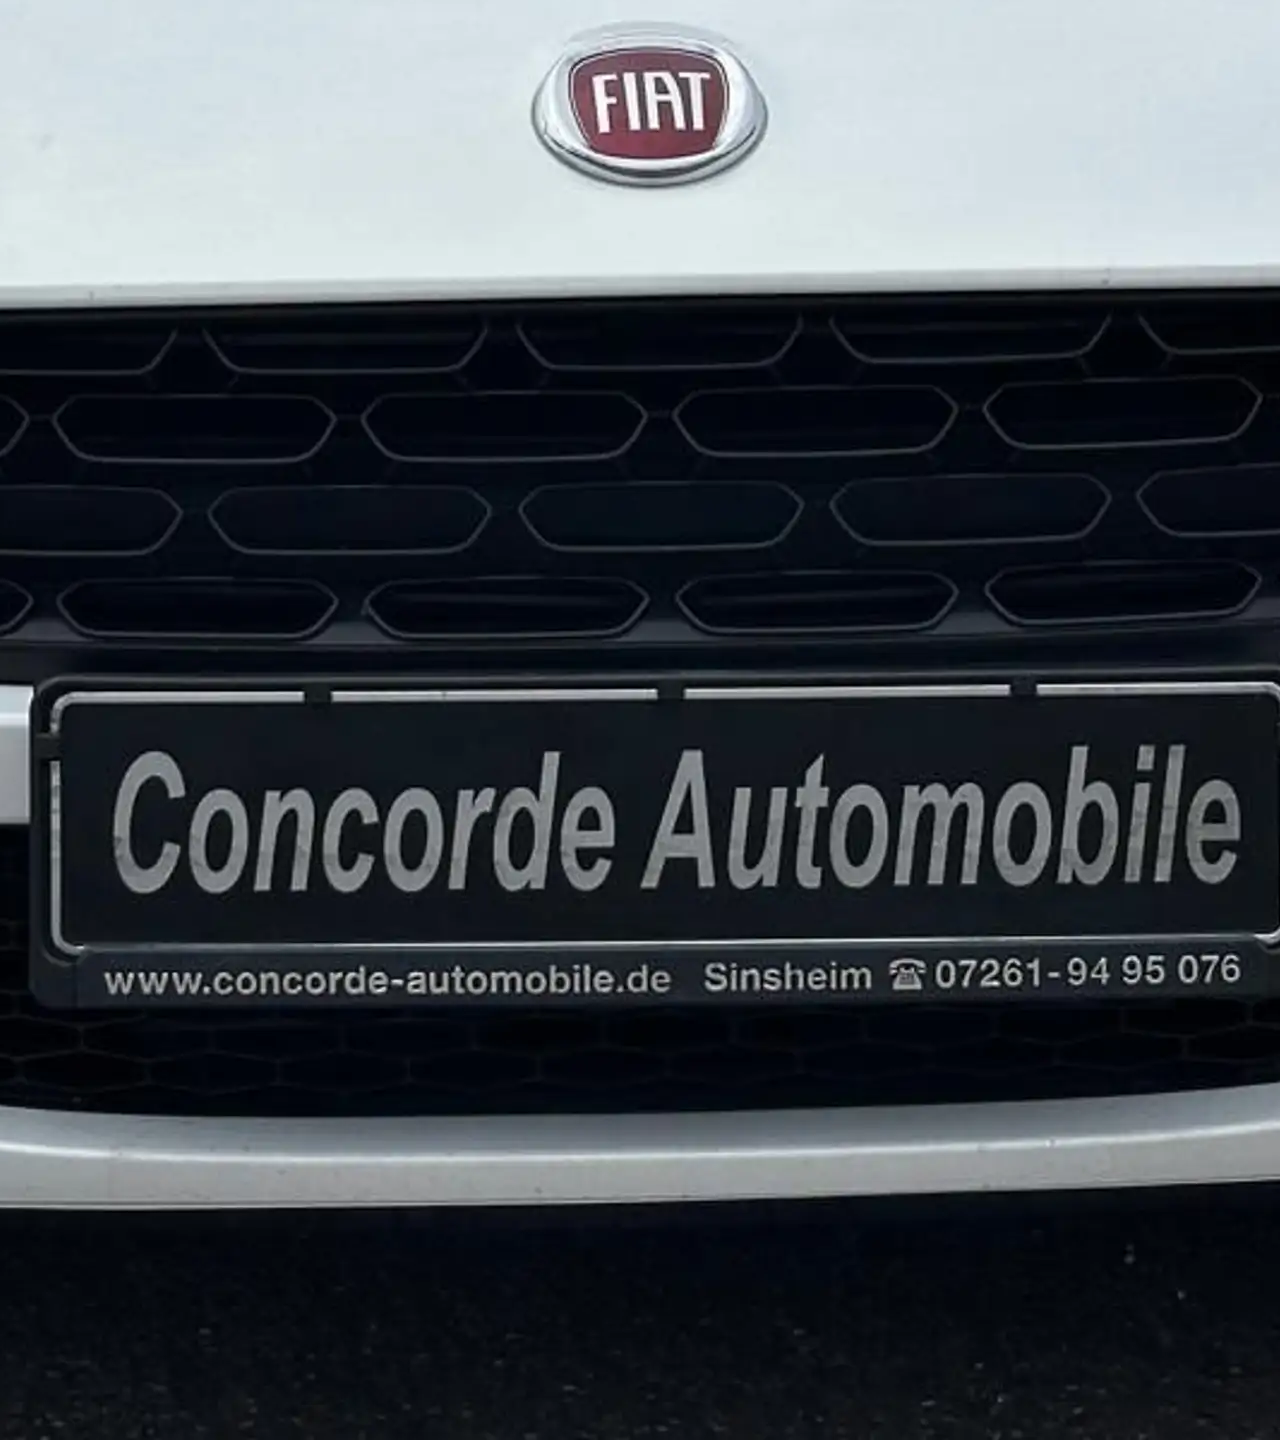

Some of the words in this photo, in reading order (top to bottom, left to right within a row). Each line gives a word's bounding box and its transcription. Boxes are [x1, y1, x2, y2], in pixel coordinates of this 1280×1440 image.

[592, 71, 711, 134] FIAT
[113, 750, 616, 894] Concorde
[640, 744, 1242, 889] Automobile
[104, 964, 671, 996] www.concorde-automobile.de
[704, 961, 873, 991] Sinsheim
[1122, 955, 1166, 985] 95
[1178, 955, 1242, 983] 076
